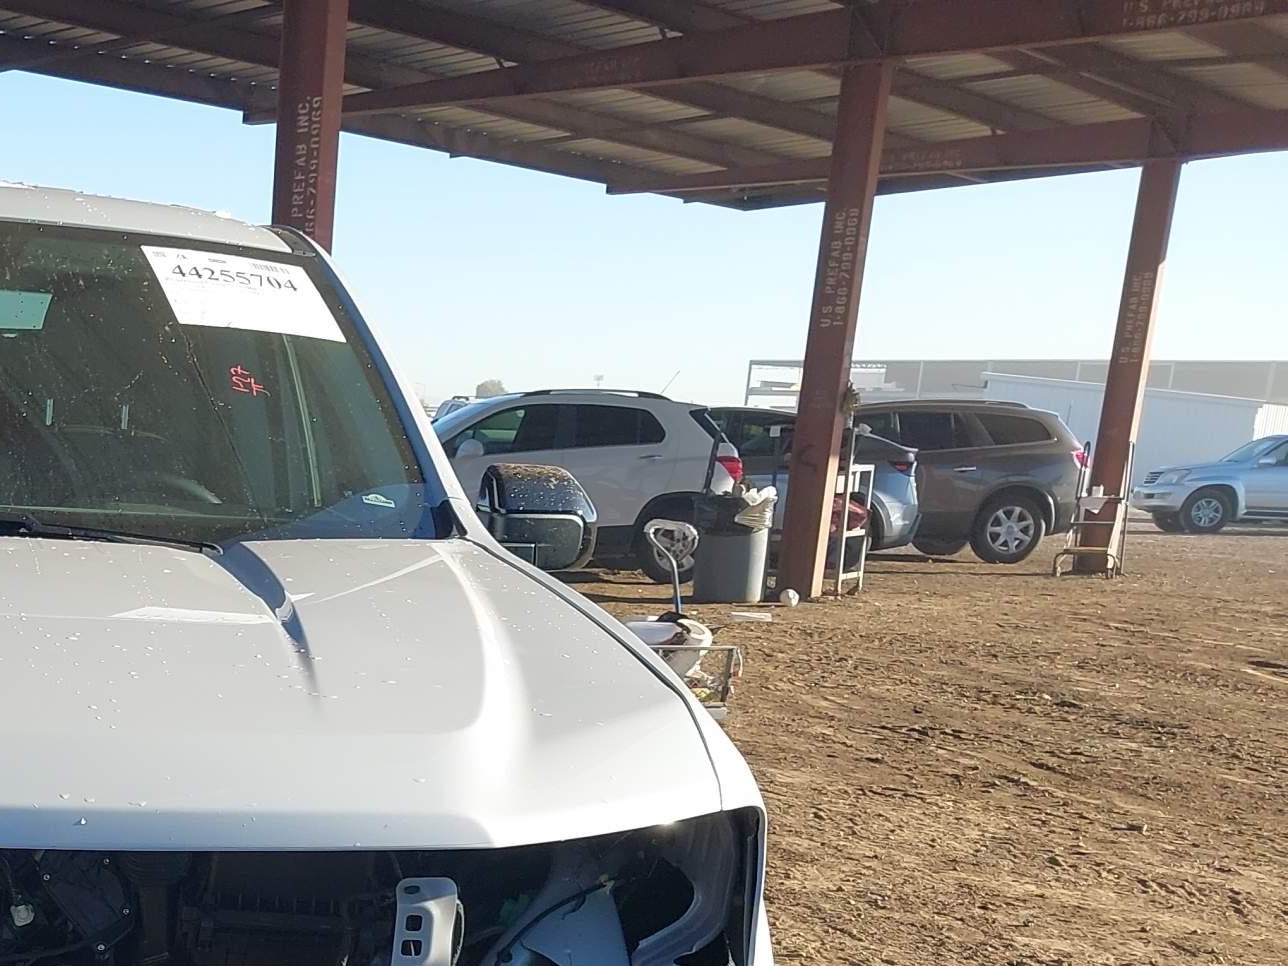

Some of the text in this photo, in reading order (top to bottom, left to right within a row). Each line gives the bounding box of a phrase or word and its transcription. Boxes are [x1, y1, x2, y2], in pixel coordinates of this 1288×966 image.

[291, 96, 311, 217] PREFAB INC.
[171, 264, 298, 292] 44255704
[824, 241, 843, 294] PREFAB
